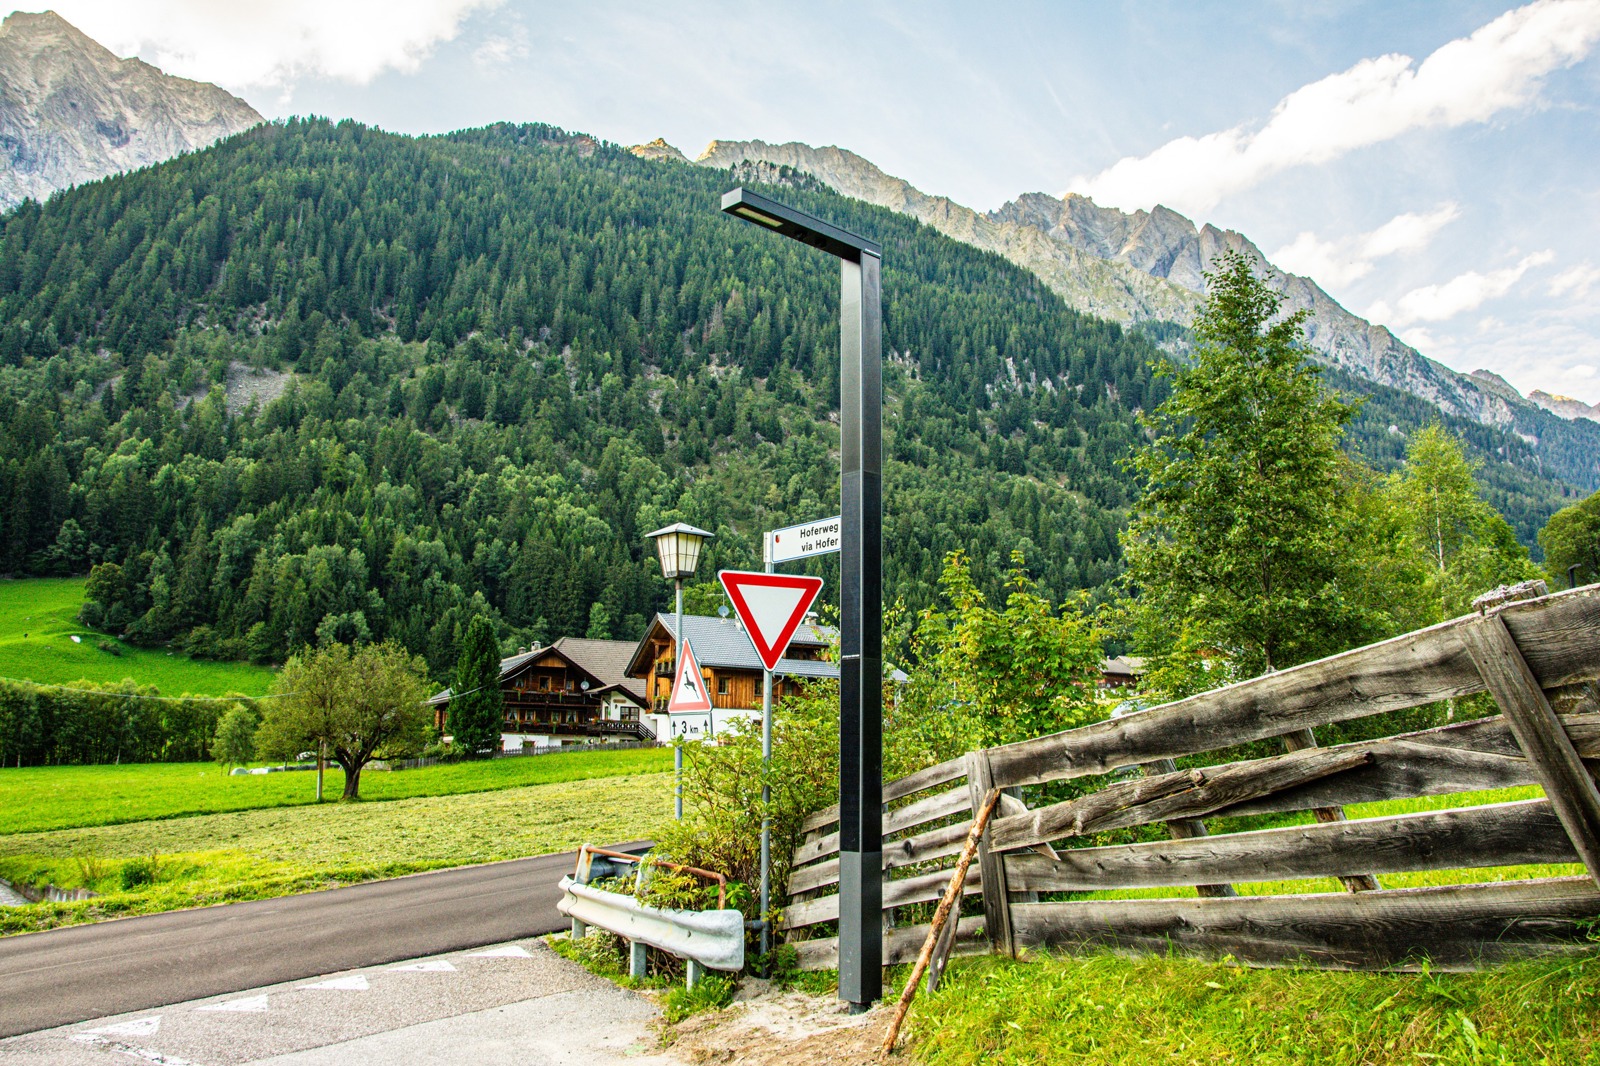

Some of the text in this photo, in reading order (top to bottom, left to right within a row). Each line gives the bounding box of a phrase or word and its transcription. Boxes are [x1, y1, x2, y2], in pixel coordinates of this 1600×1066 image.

[800, 523, 839, 538] Hoferweg
[801, 537, 839, 552] via Hofer
[681, 720, 698, 734] 3 km
